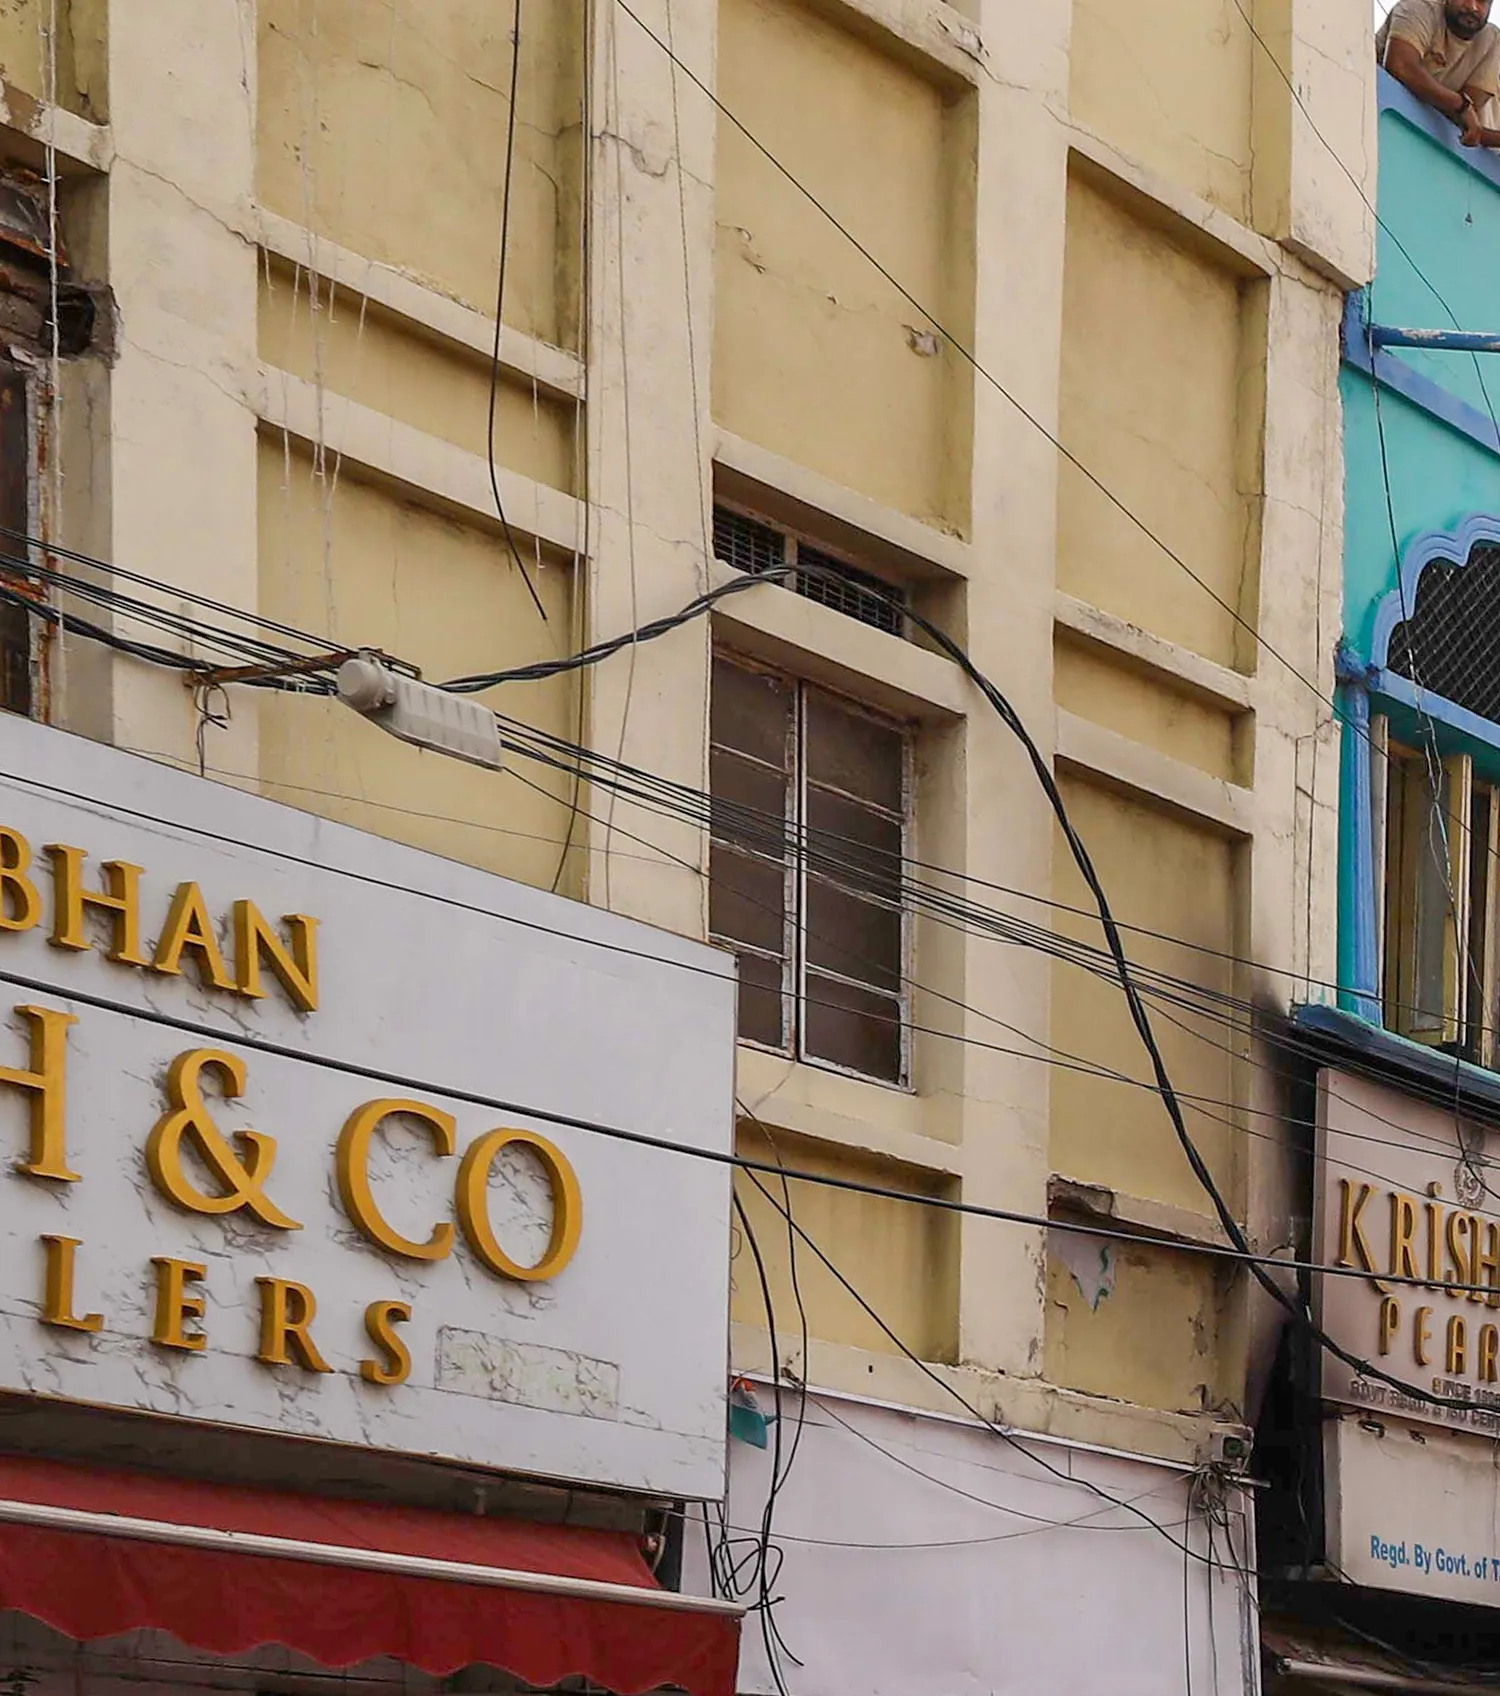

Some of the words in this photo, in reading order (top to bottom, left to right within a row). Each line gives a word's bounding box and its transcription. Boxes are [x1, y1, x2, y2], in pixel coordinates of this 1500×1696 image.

[145, 1048, 303, 1230] &
[336, 1098, 583, 1282] CO
[40, 1234, 413, 1385] LERS
[1432, 1377, 1471, 1401] SINCE
[1371, 1536, 1409, 1568] Regd.
[1415, 1544, 1431, 1574] By
[1436, 1548, 1470, 1577] Govt.
[1475, 1557, 1487, 1579] of
